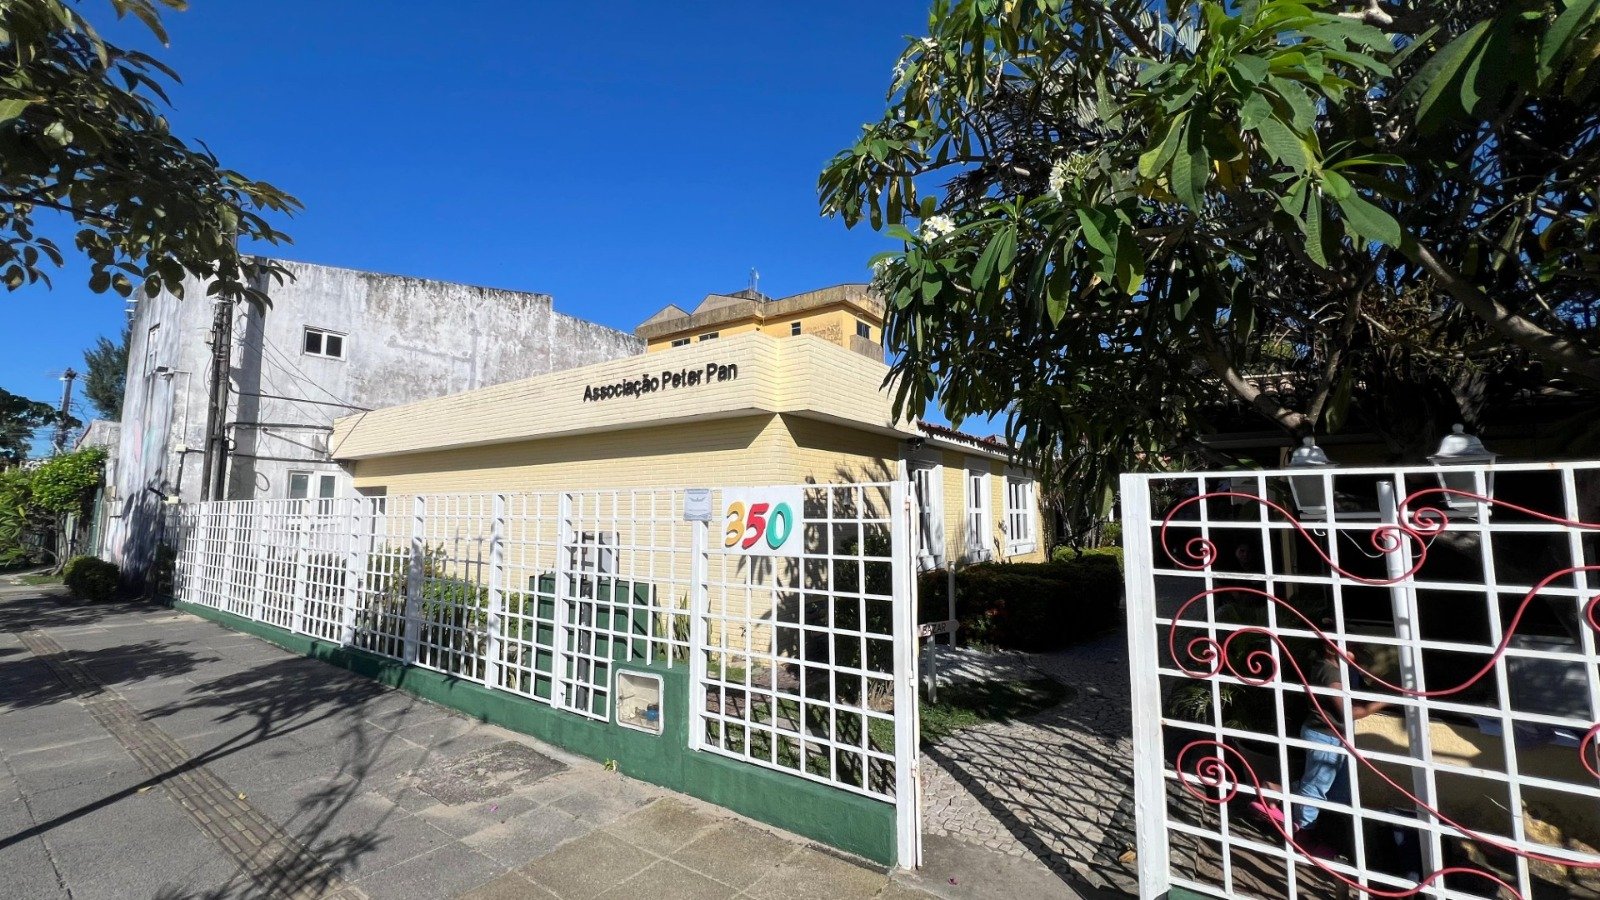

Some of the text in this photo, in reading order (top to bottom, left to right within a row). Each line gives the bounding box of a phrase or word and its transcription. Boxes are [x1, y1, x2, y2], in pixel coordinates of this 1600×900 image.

[583, 362, 738, 402] Associação Peter Pan
[725, 501, 793, 550] 350
[923, 622, 946, 635] BAZAR
